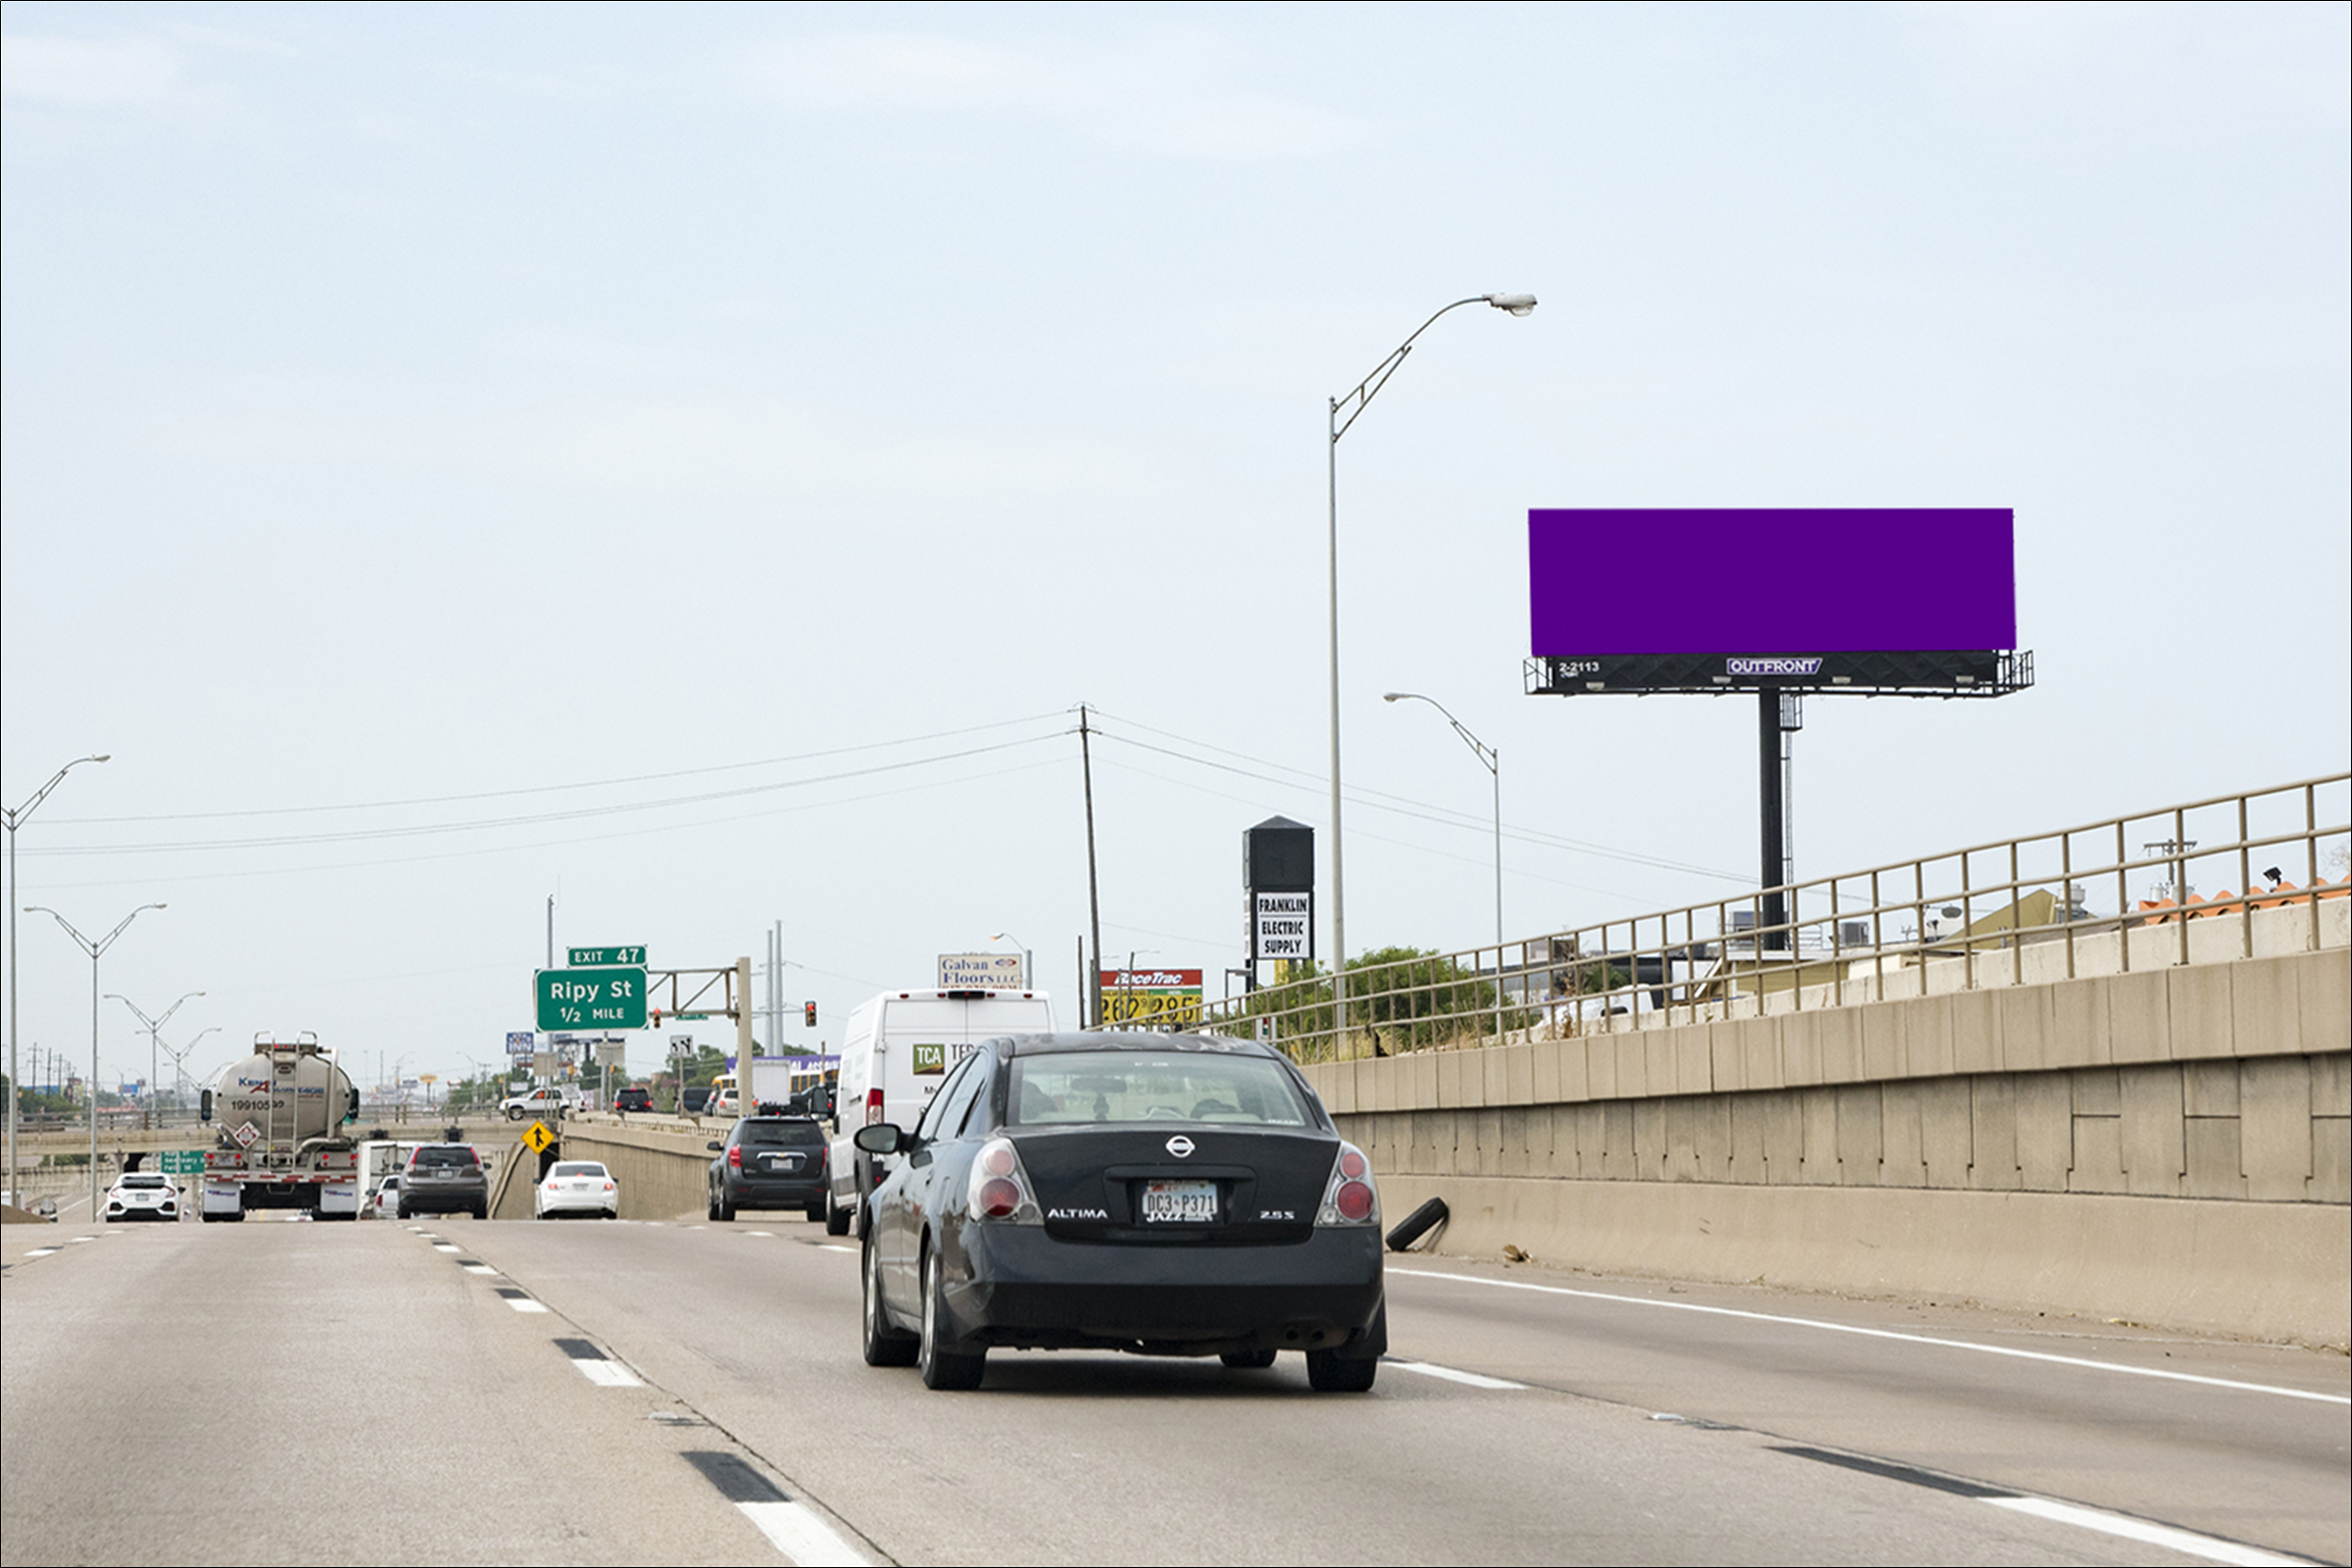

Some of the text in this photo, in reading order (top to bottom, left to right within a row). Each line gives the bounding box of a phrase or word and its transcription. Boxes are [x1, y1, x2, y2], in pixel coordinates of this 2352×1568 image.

[1559, 662, 1599, 672] 2-2113
[1730, 660, 1816, 673] OUTFRONT
[1259, 899, 1307, 912] FRANKLIN
[1261, 921, 1303, 935] ELECTRIC
[1264, 940, 1301, 954] SUPPLY
[574, 948, 639, 962] EXIT 47
[942, 958, 989, 970] Galvan
[943, 972, 995, 984] Floors
[1113, 972, 1183, 985] RaceTrac
[551, 980, 632, 1004] Ripy St
[592, 1007, 624, 1019] MILE
[917, 1047, 942, 1064] TCA
[1048, 1208, 1108, 1219] ALTIMA
